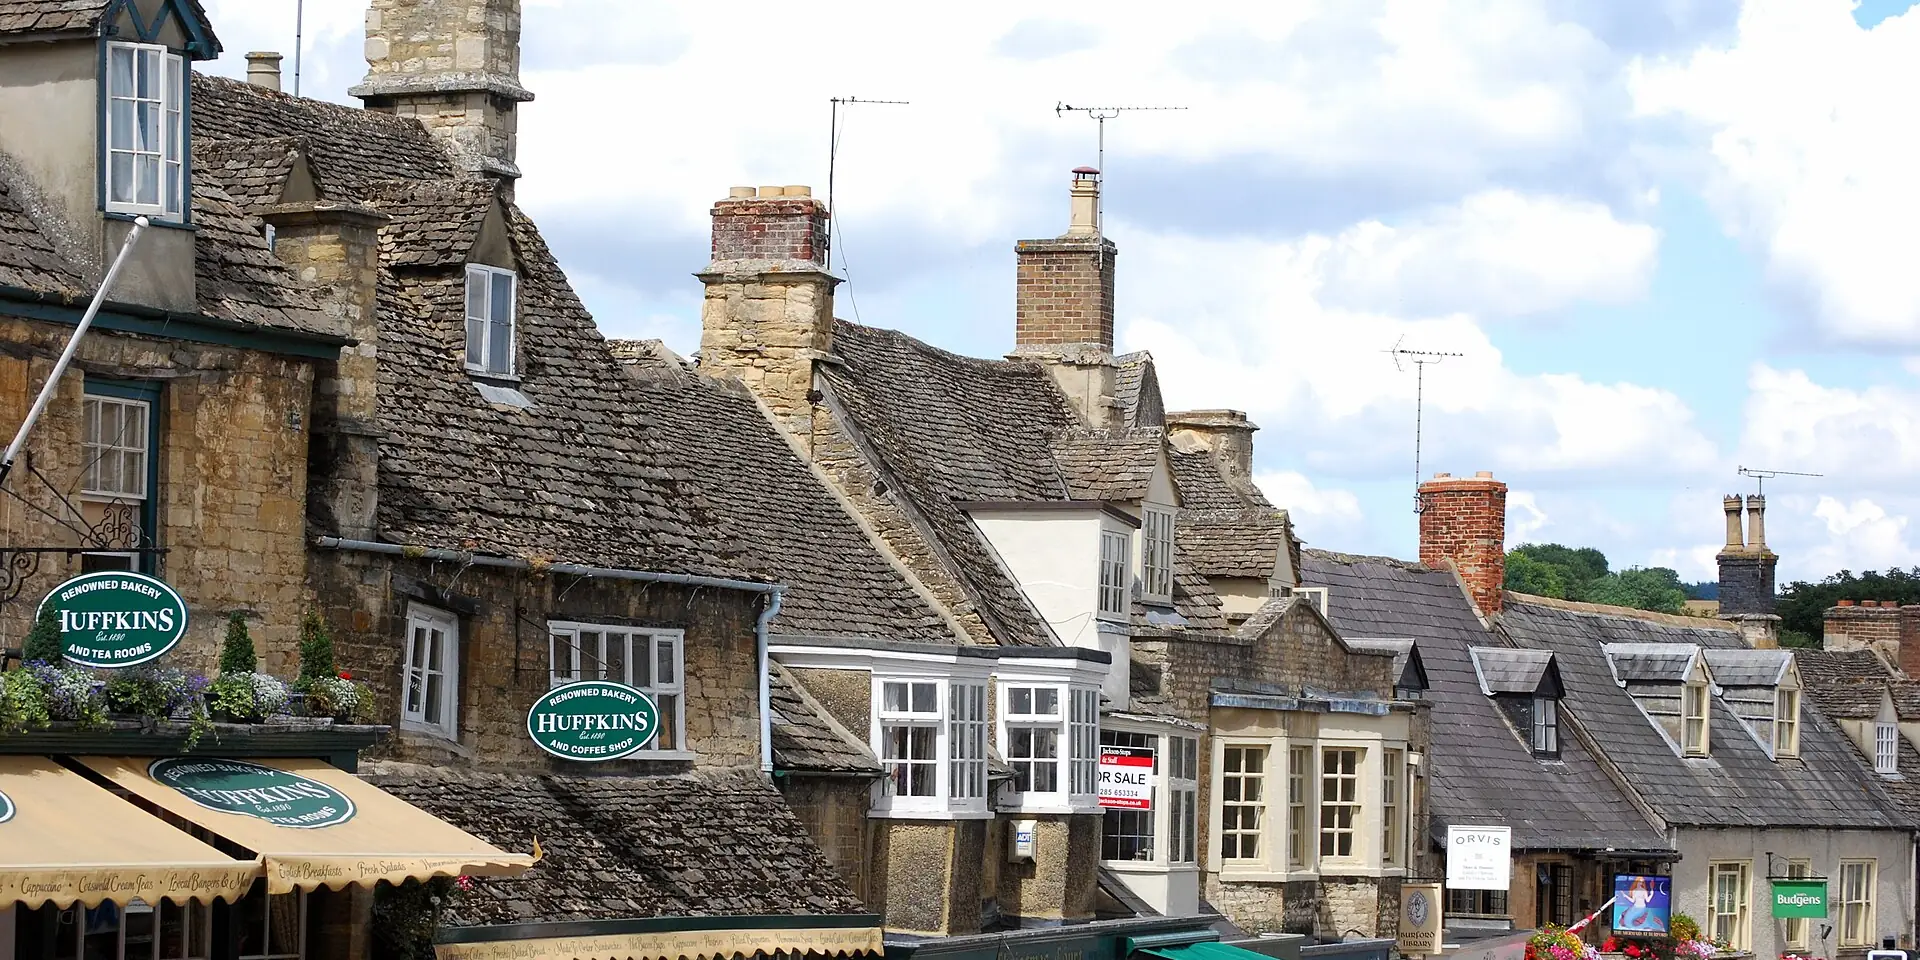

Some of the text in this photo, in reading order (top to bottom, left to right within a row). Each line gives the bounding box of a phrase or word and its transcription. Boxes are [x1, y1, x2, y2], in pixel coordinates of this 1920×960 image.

[61, 580, 162, 602] RENOWNED BAKERY
[58, 607, 174, 633] HUFFKINS
[67, 642, 152, 659] AND TEA ROOMS
[550, 688, 637, 707] RENOWNED BAKERY
[537, 711, 648, 733] HUFFKINS
[549, 737, 633, 755] AND COFFEE SHOP
[1114, 772, 1146, 785] SALE
[275, 816, 301, 825] TEA
[302, 805, 337, 823] ROOMS
[1455, 834, 1501, 846] ORVIS
[302, 861, 343, 880] Breakfasts
[357, 861, 379, 878] Fresh
[379, 859, 406, 874] Salads
[21, 877, 62, 897] Cappuccino
[78, 876, 111, 893] Cotswold
[110, 875, 135, 892] Cream
[136, 874, 153, 894] Teas
[168, 872, 191, 892] Local
[191, 872, 220, 893] Bangers
[1777, 893, 1821, 907] Budgens
[1401, 931, 1435, 939] BURFORD
